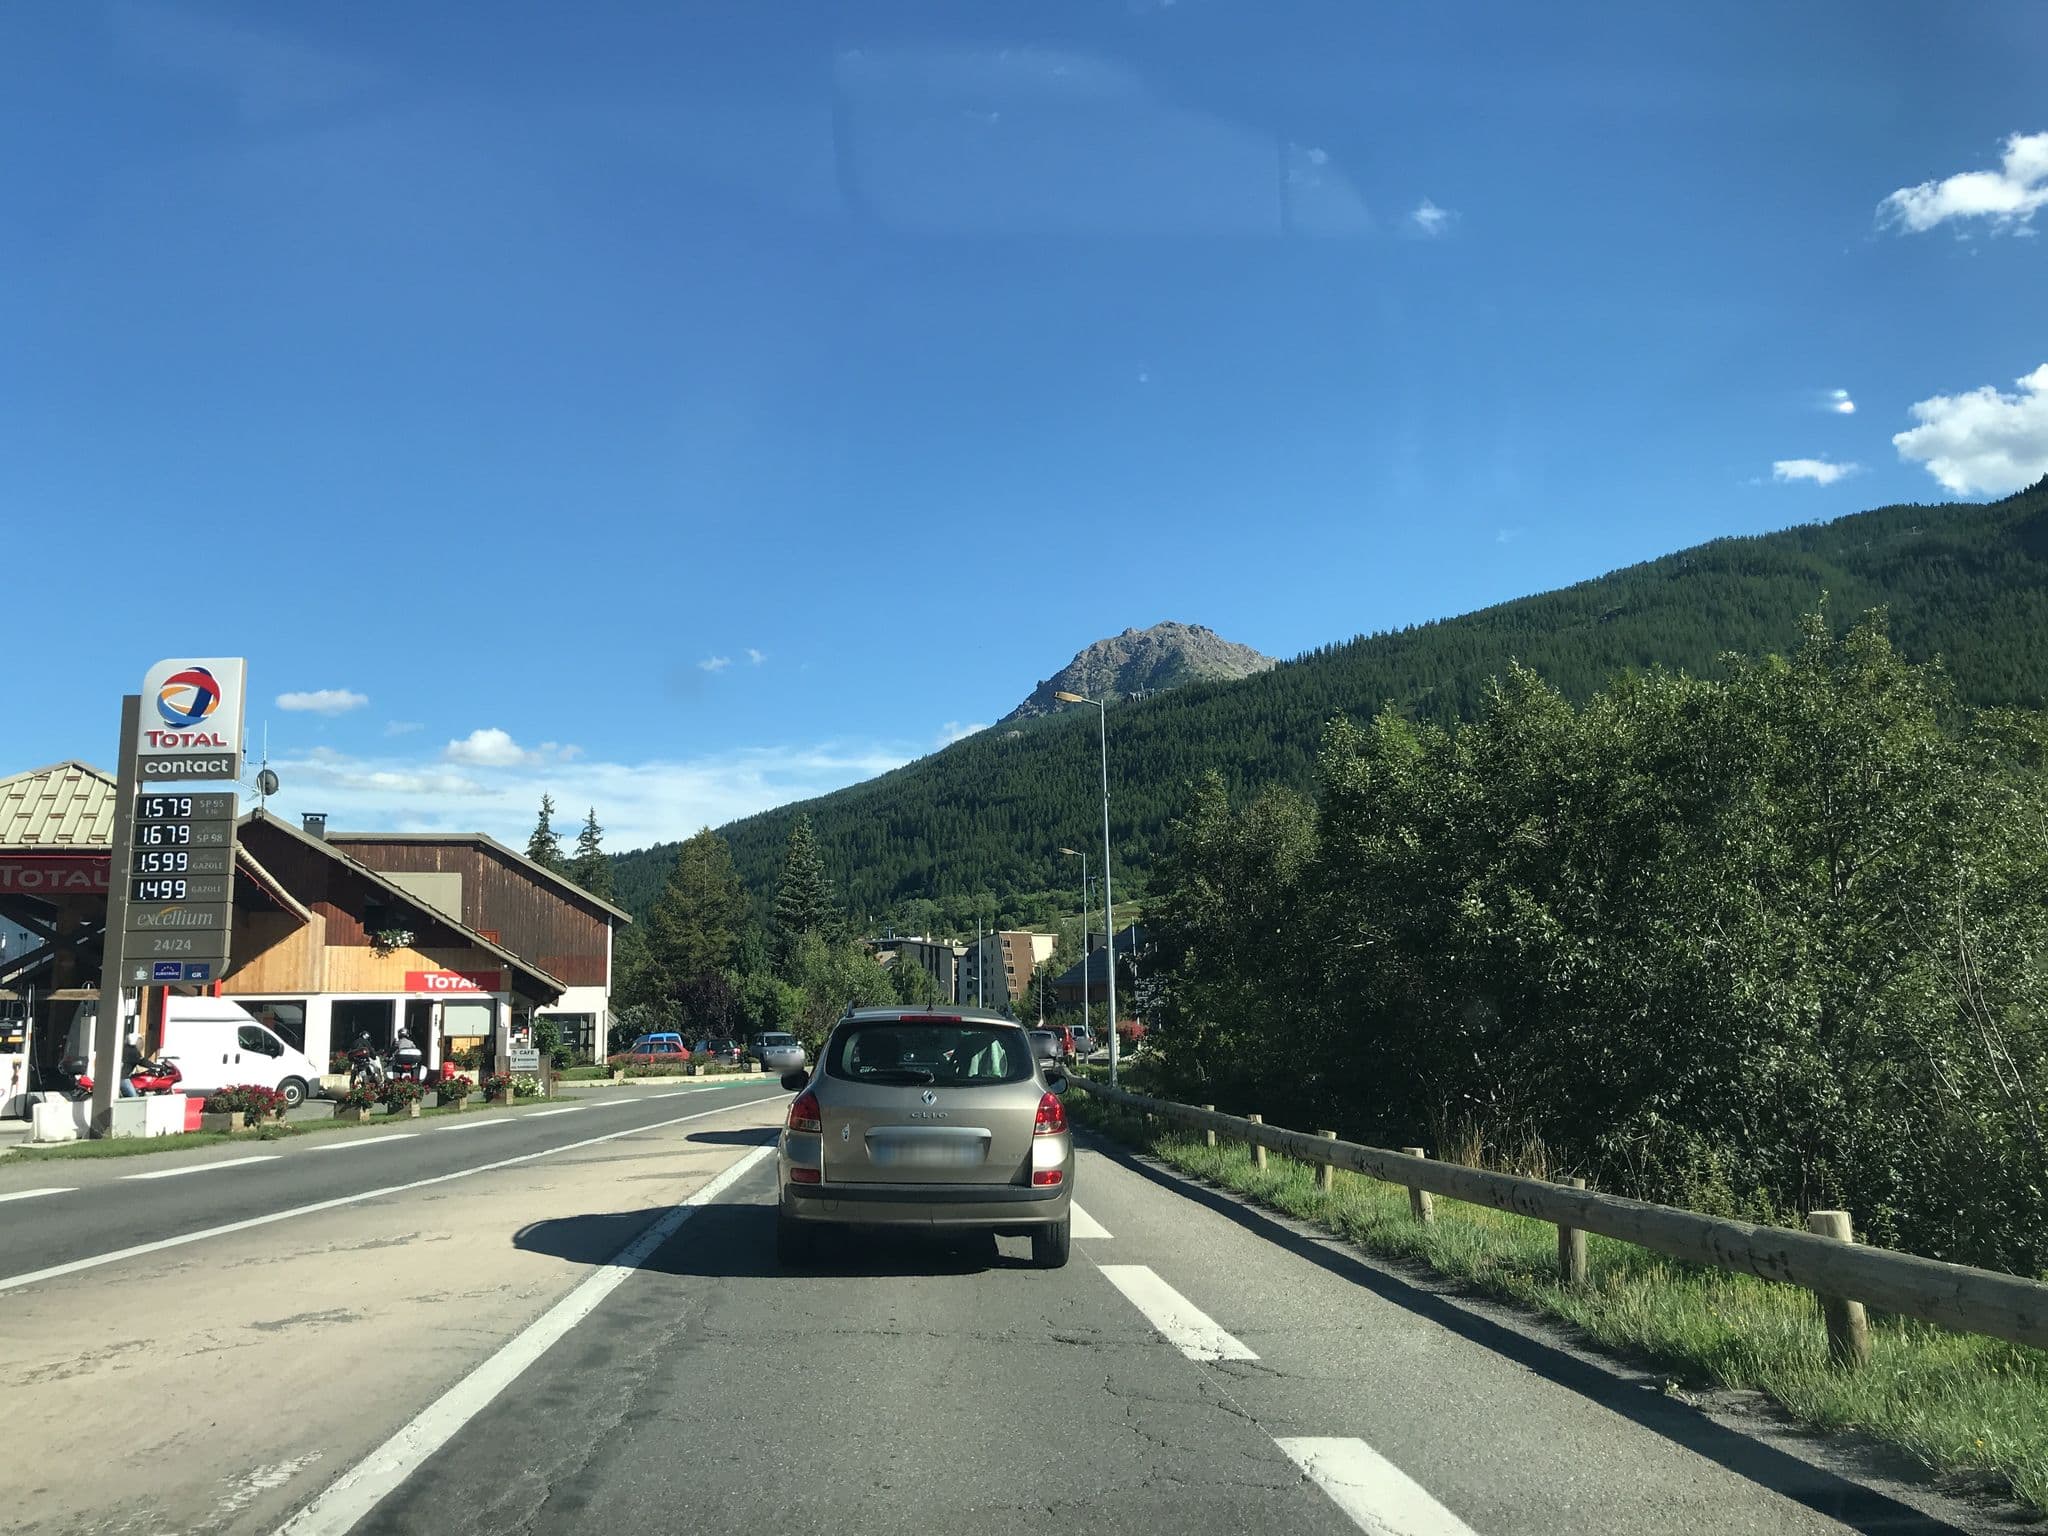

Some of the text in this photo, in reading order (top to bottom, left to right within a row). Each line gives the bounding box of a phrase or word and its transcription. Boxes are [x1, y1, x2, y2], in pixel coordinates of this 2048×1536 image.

[145, 730, 229, 748] TOTAL
[144, 758, 229, 775] contact
[145, 798, 192, 818] 1.579
[199, 799, 225, 808] SP 95
[143, 825, 191, 845] 1.679
[196, 833, 223, 843] SP 98
[141, 852, 188, 872] 1.599
[192, 862, 224, 870] GAZOLE
[0, 865, 110, 888] TOTAL
[139, 879, 187, 900] 1.499
[137, 910, 214, 927] excellium
[153, 938, 192, 952] 24/24
[423, 974, 481, 989] TOTAL
[911, 1111, 949, 1119] CLIO
